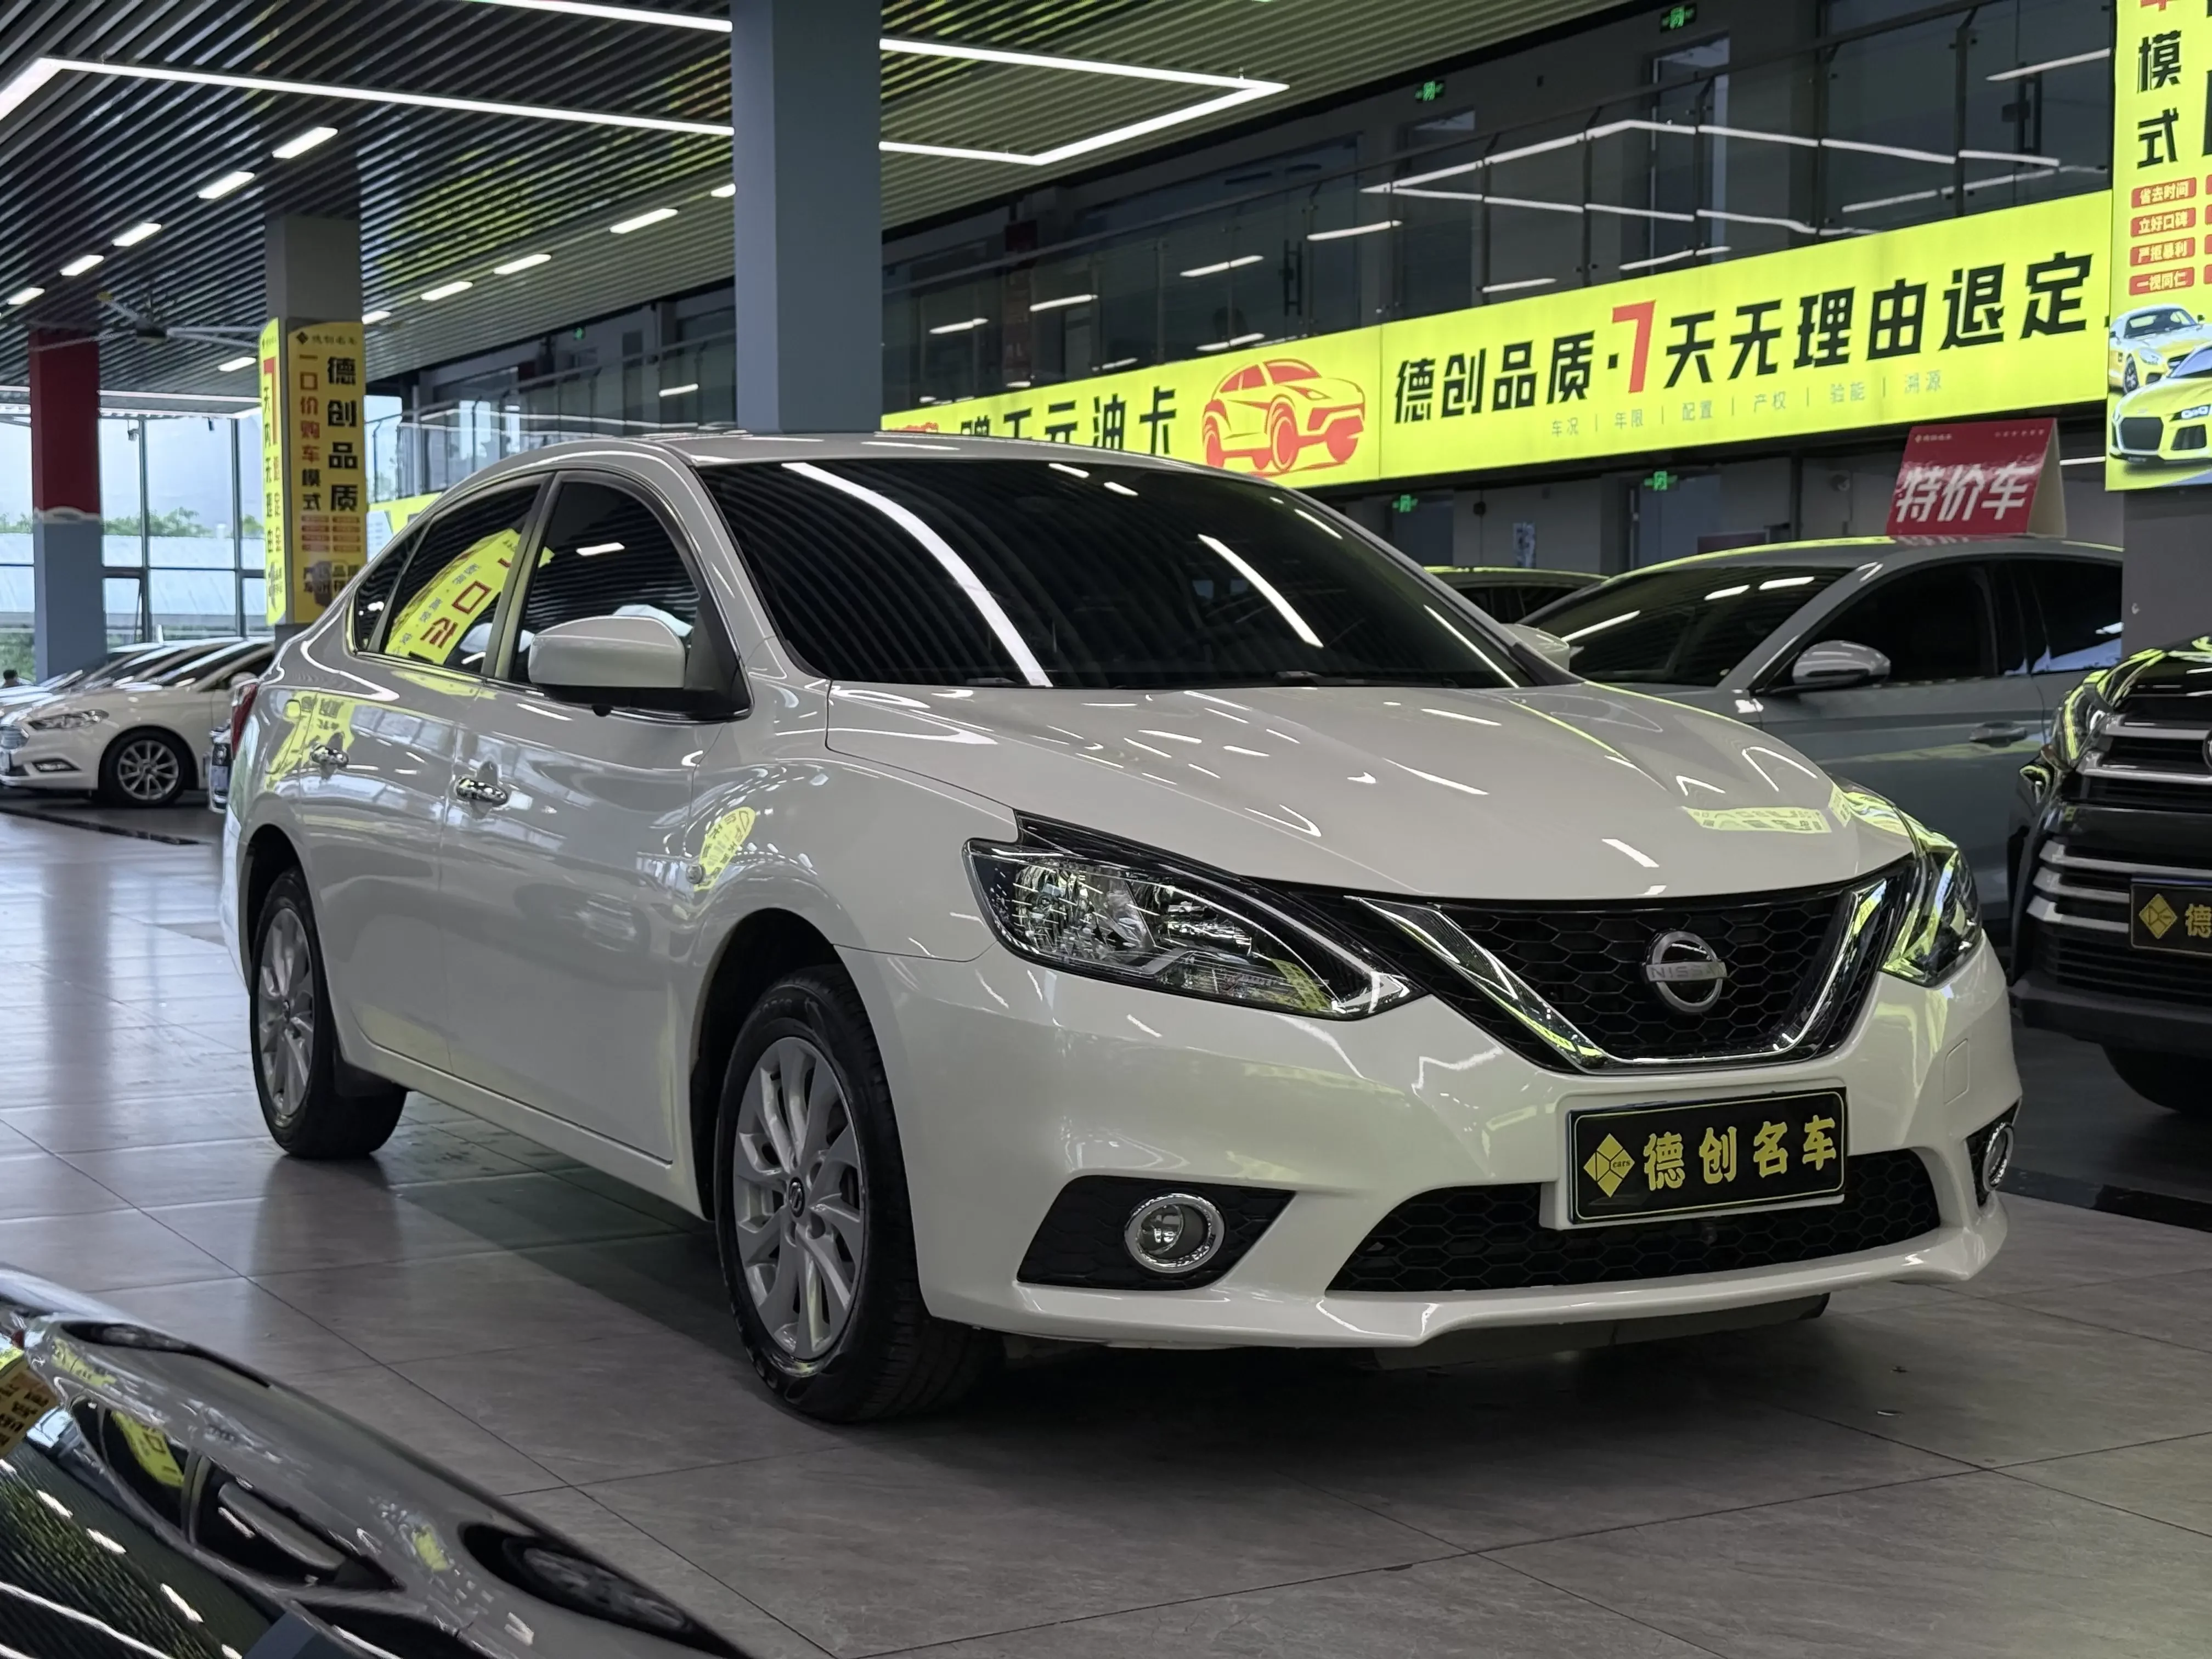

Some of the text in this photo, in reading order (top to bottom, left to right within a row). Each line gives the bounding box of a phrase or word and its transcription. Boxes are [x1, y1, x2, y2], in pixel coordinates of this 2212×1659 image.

[2137, 0, 2182, 168] 模式
[2140, 181, 2189, 205] 省去时间
[2138, 211, 2188, 234] 立好口碑
[2136, 271, 2186, 291] 一视同仁
[300, 354, 320, 511] 一口价购车模式
[1551, 417, 1578, 437] 车况
[1615, 409, 1644, 429] 年限
[1682, 400, 1712, 421] 配置
[1753, 391, 1786, 413] 产权
[328, 357, 358, 512] 德创品质
[1896, 461, 2037, 522] 特价车
[2185, 904, 2212, 939] 德
[1650, 962, 1724, 979] NISSAN
[1613, 1160, 1631, 1169] cars
[1644, 1115, 1836, 1190] 德创名车
